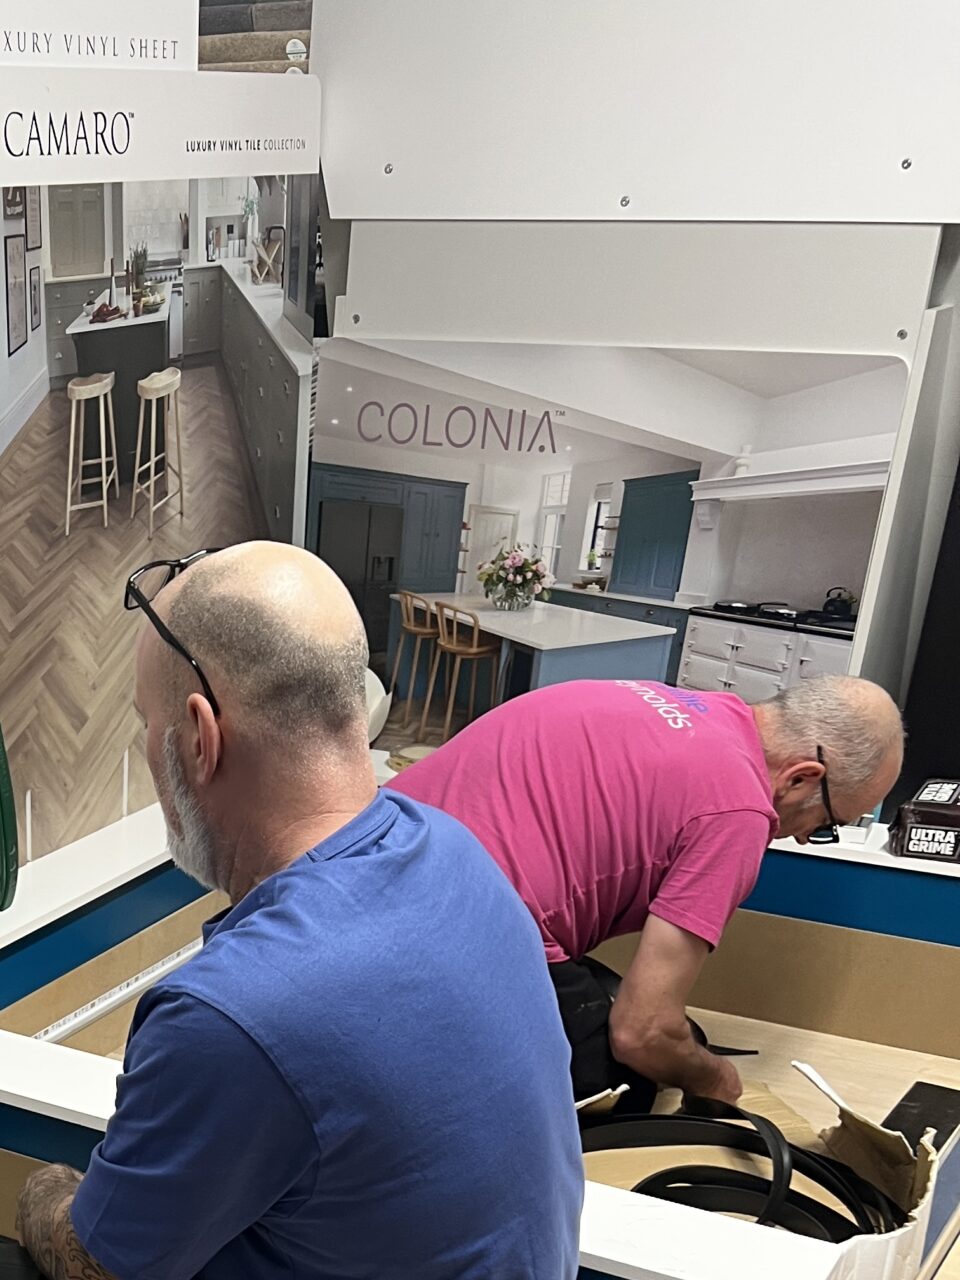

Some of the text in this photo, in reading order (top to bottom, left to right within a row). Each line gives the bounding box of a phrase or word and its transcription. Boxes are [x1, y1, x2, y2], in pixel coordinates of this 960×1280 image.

[64, 34, 119, 57] VINYL
[129, 38, 179, 60] SHEET
[186, 138, 306, 152] LUXURY VINYL TILE COLLECTION
[910, 828, 956, 843] ULTRA
[908, 839, 955, 855] GRIME
